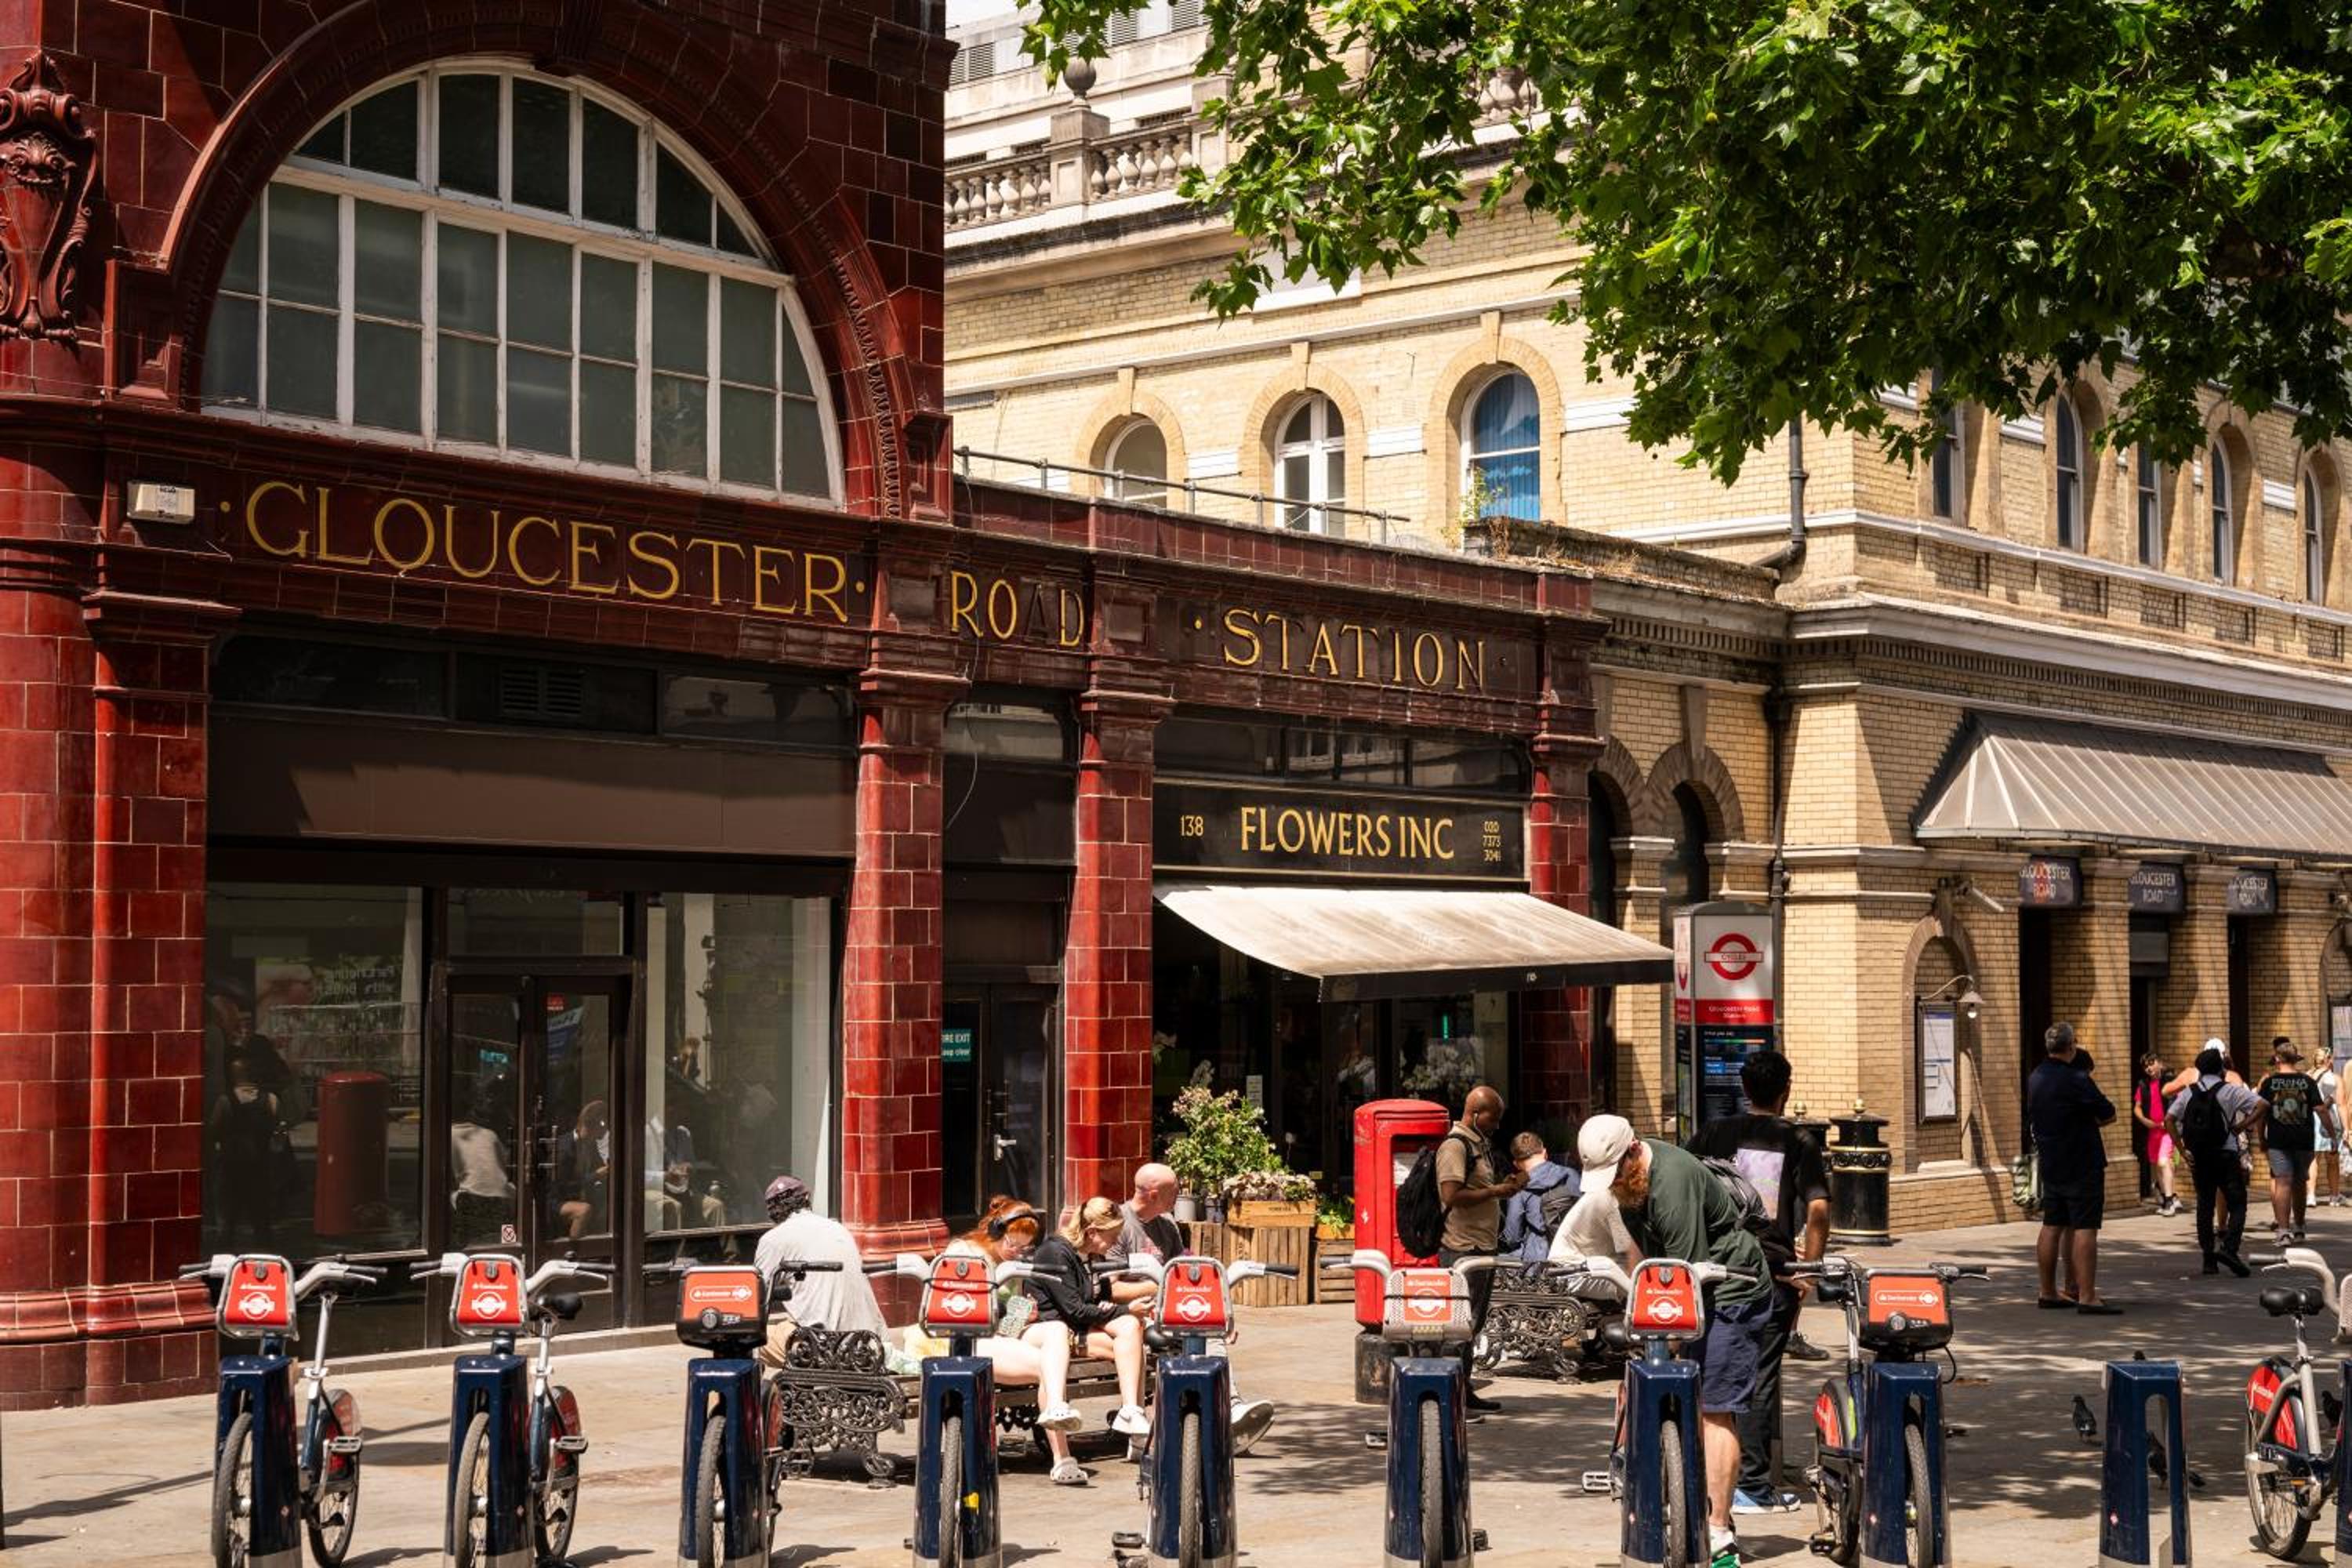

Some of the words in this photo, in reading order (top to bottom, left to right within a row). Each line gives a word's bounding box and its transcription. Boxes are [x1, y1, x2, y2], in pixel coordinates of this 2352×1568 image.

[246, 480, 849, 624] GLOUCESTER
[950, 569, 1084, 648] ROAD
[1223, 608, 1486, 691] STATION
[1179, 815, 1204, 837] 138
[1240, 806, 1392, 858] FLOWERS
[1399, 816, 1454, 860] INC
